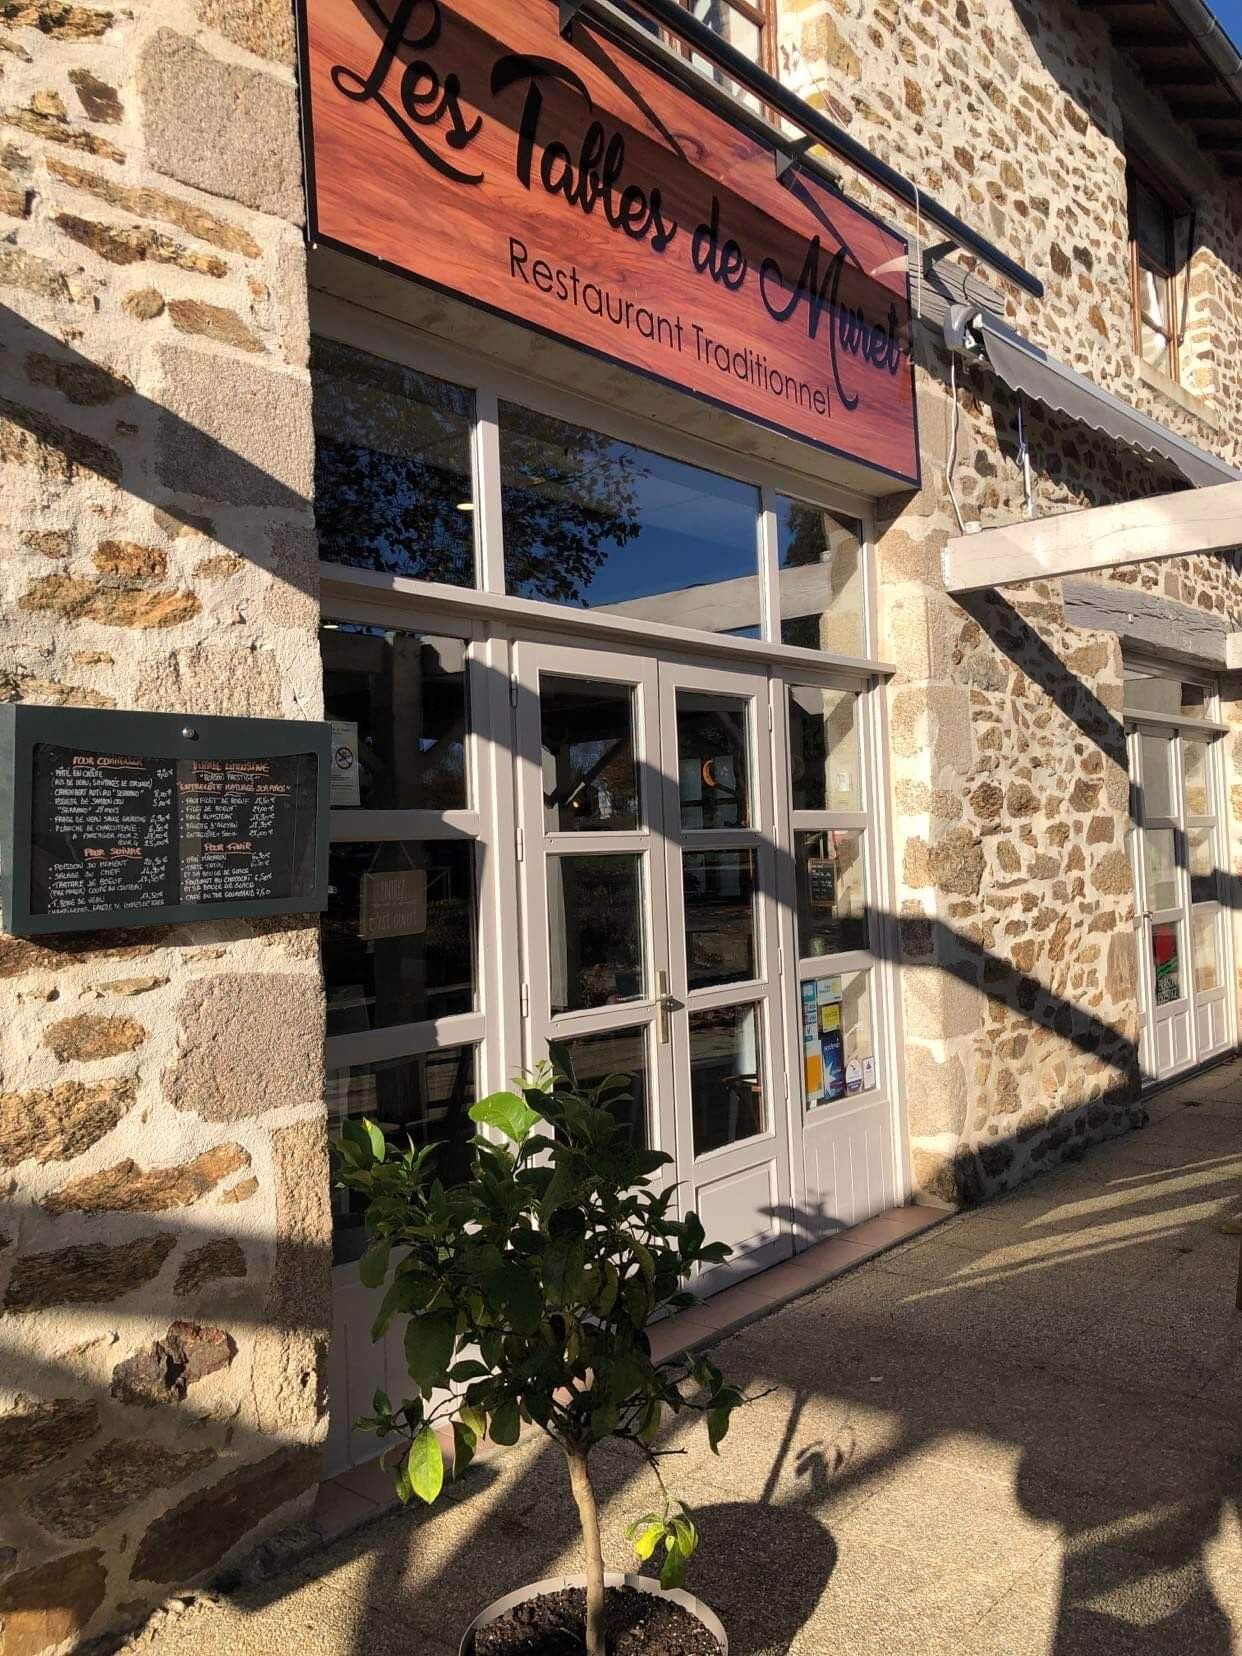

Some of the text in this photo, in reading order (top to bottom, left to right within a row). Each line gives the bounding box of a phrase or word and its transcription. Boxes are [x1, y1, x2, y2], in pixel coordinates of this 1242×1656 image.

[331, 0, 899, 410] Les Tables de Muret
[509, 237, 832, 417] Restaurant Traditionnel
[204, 842, 252, 851] POUR FINIR
[99, 860, 127, 868] MOMENT
[100, 868, 121, 876] CHEF
